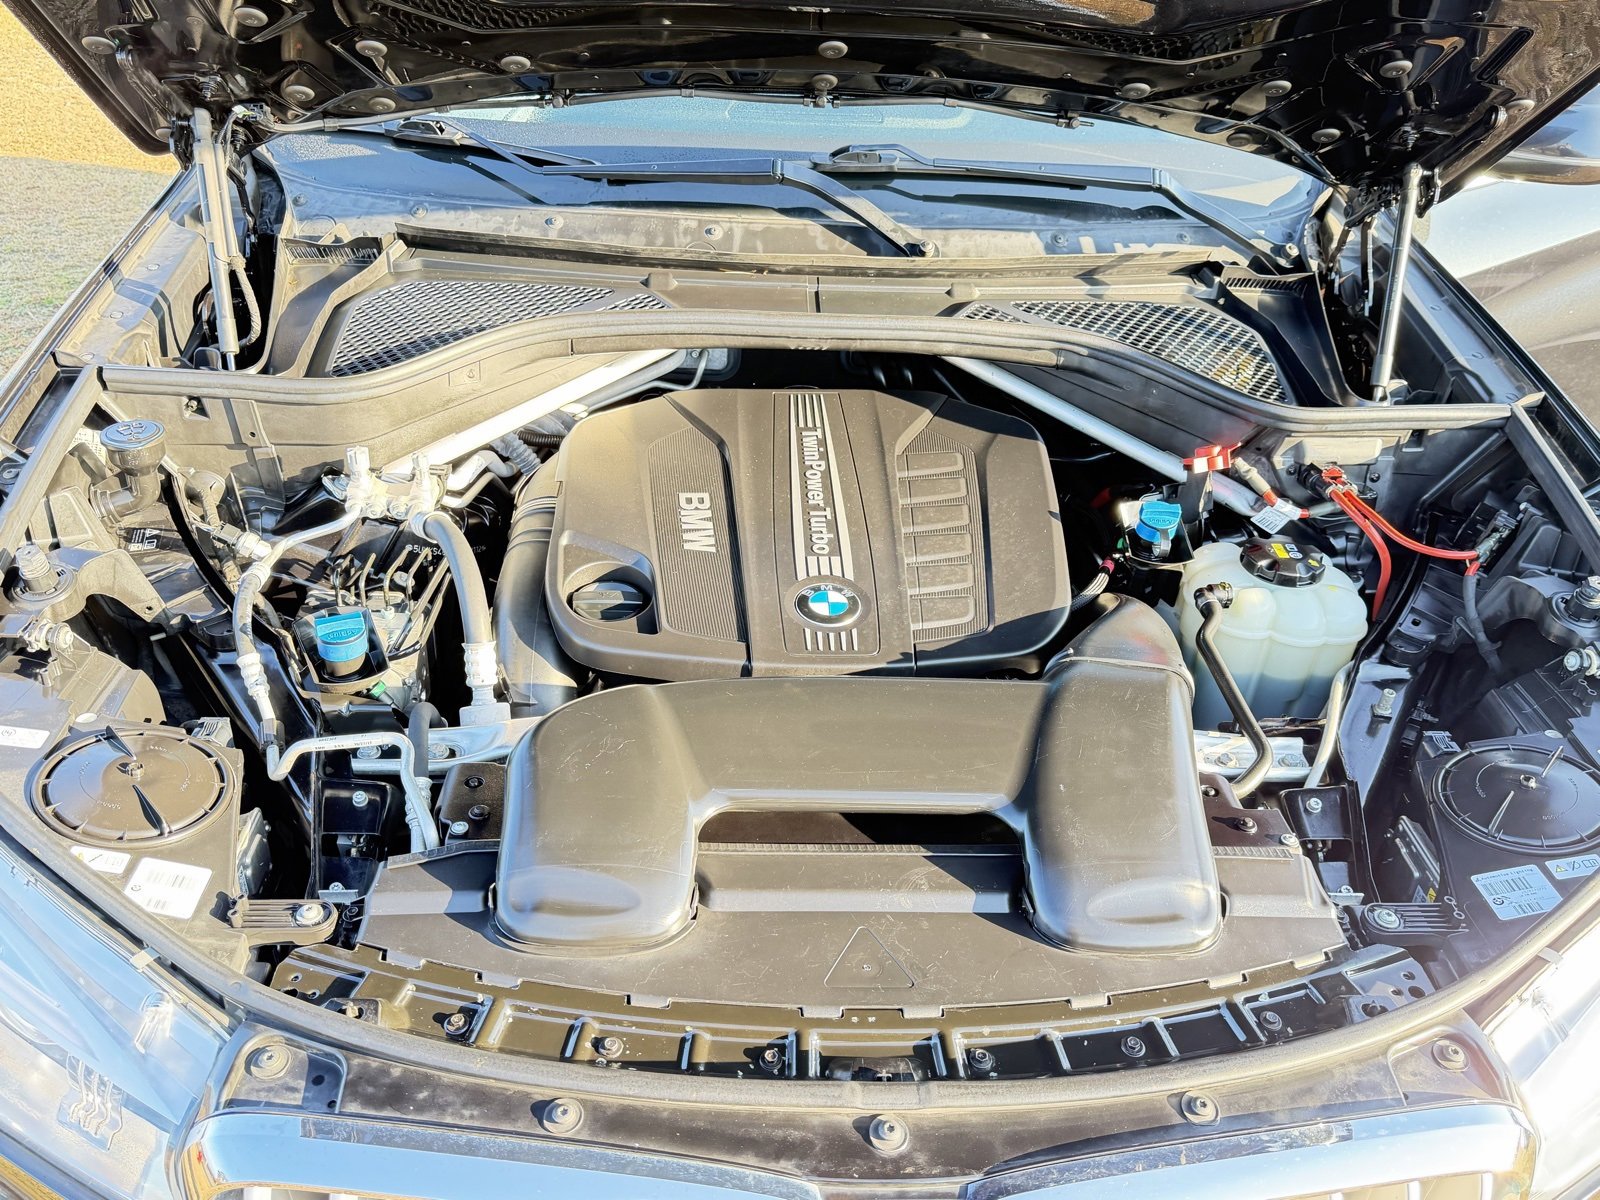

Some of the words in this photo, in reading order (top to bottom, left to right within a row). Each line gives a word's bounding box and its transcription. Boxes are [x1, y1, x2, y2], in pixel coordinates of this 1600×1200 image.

[800, 428, 825, 507] TwinPower
[678, 492, 717, 553] BMW
[809, 507, 834, 555] Turbo
[801, 585, 854, 597] BMW
